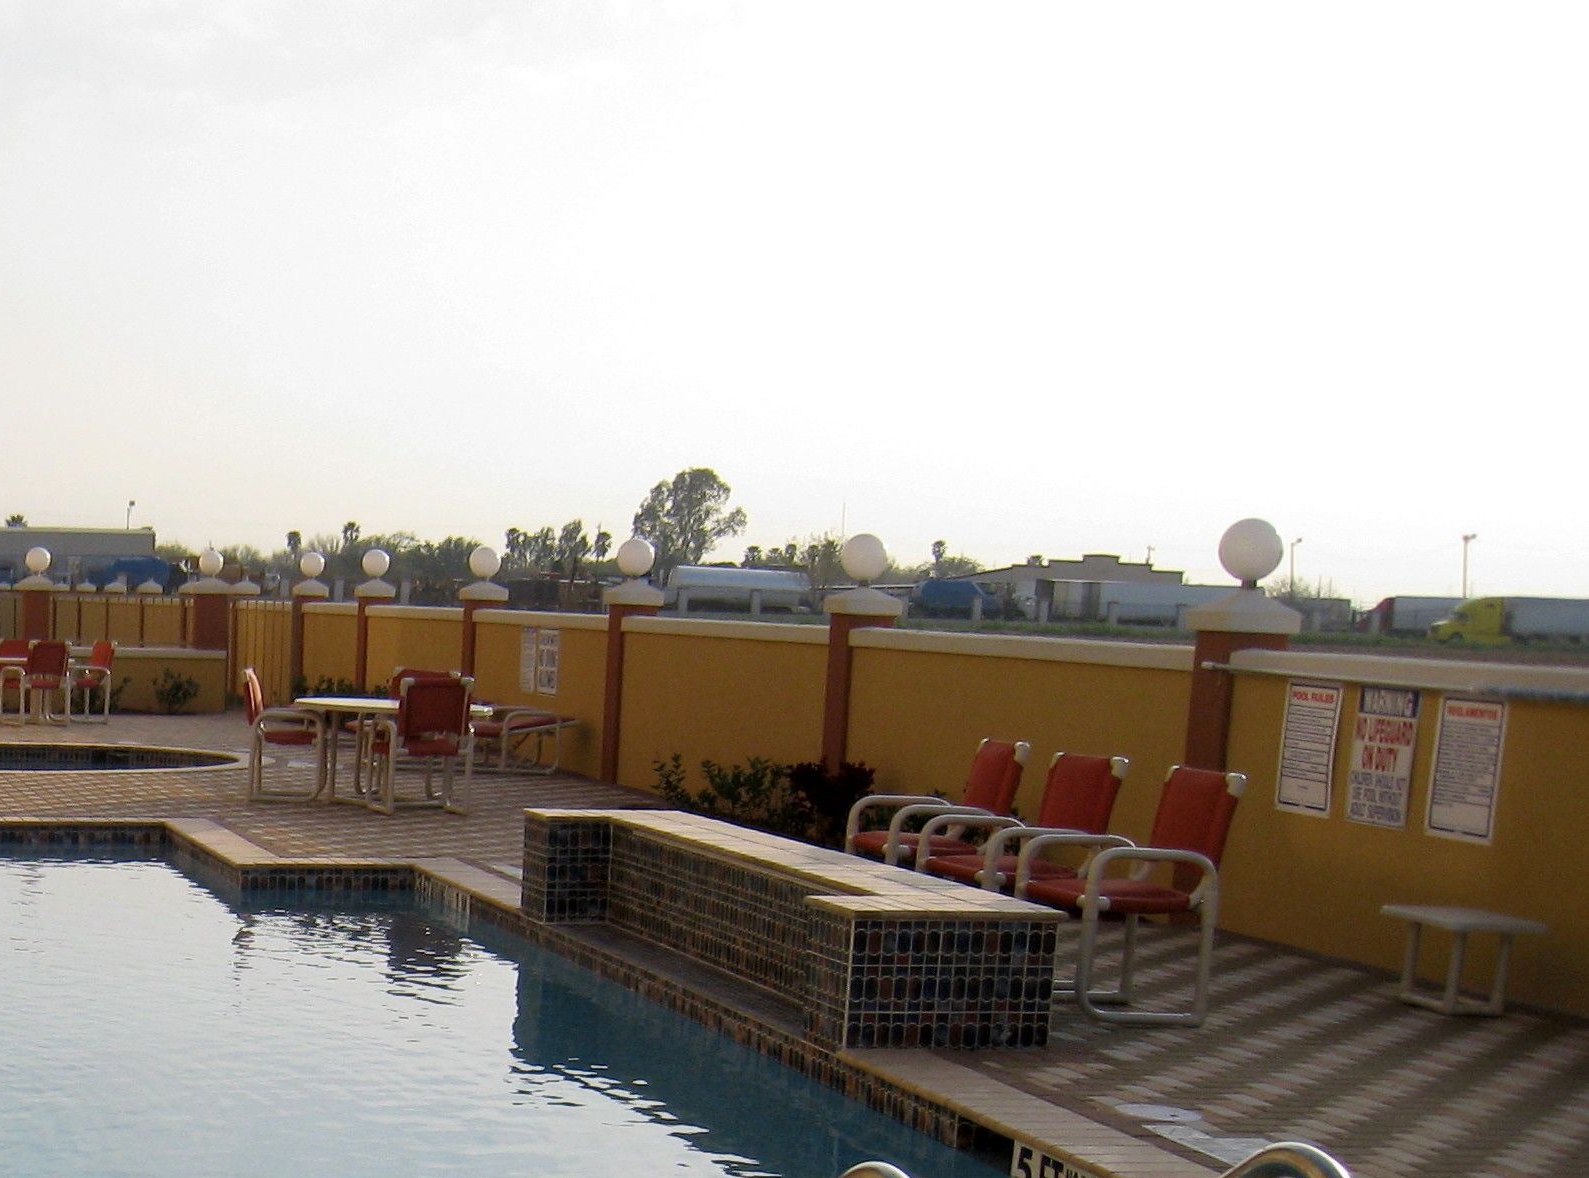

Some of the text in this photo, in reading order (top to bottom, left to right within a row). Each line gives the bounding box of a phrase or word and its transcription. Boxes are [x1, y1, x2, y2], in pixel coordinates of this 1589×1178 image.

[1356, 716, 1414, 746] NO LIFEGUARD
[1362, 745, 1399, 773] ON DUTY
